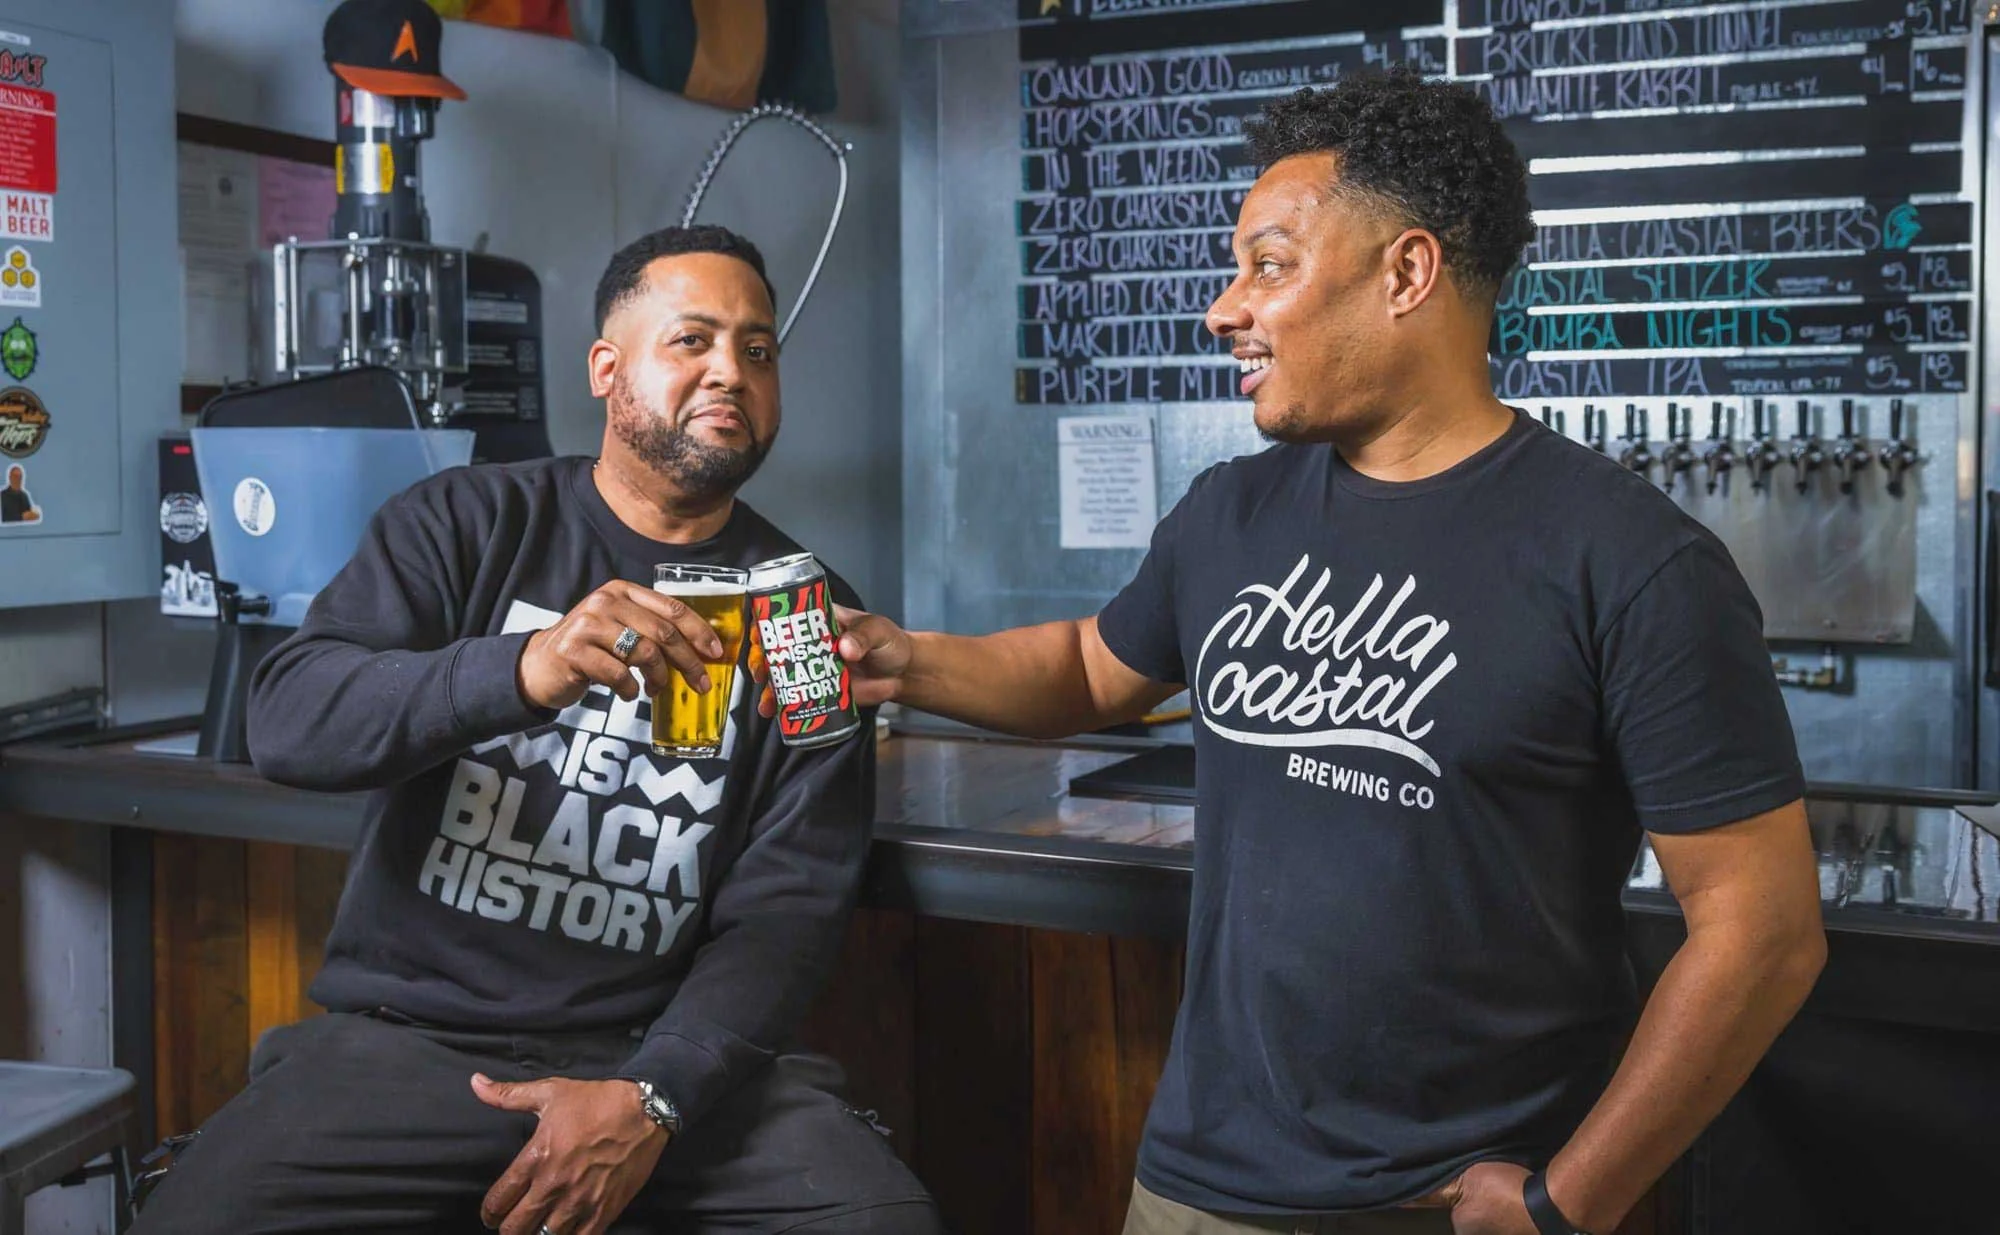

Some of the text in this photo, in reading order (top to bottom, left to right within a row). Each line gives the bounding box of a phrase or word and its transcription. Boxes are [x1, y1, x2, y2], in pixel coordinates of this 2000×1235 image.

[1032, 60, 1155, 101] OAKLAND
[1164, 53, 1234, 95] GOLD
[1042, 150, 1070, 191] IN
[1083, 148, 1127, 187] THE
[1138, 145, 1221, 185] WEEDS
[7, 194, 48, 216] MALT
[8, 215, 49, 236] BEER
[1030, 190, 1233, 234] ZERO CHARISMA
[1033, 236, 1102, 273] ZERO
[1107, 231, 1215, 271] CHARISMA
[1620, 215, 1748, 259] COASTAL
[1769, 204, 1882, 252] BEERS
[1036, 280, 1130, 323] APPLIED
[1631, 259, 1773, 301] SELTZER
[1042, 320, 1176, 359] MARTIAN
[1498, 309, 1624, 355] BOMBA
[1647, 305, 1793, 350] NIGHTS
[1039, 364, 1162, 404] PURPLE
[1647, 357, 1710, 397] IPA
[758, 608, 830, 650] BEER
[1235, 553, 1450, 672] Hella
[769, 653, 840, 689] BLACK
[790, 642, 808, 662] IS
[1196, 602, 1458, 742] Coastal
[776, 675, 841, 705] HISTORY
[560, 731, 629, 796] IS
[1286, 753, 1434, 809] BREWING CO
[440, 757, 715, 898] BLACK
[418, 836, 698, 956] HISTORY
